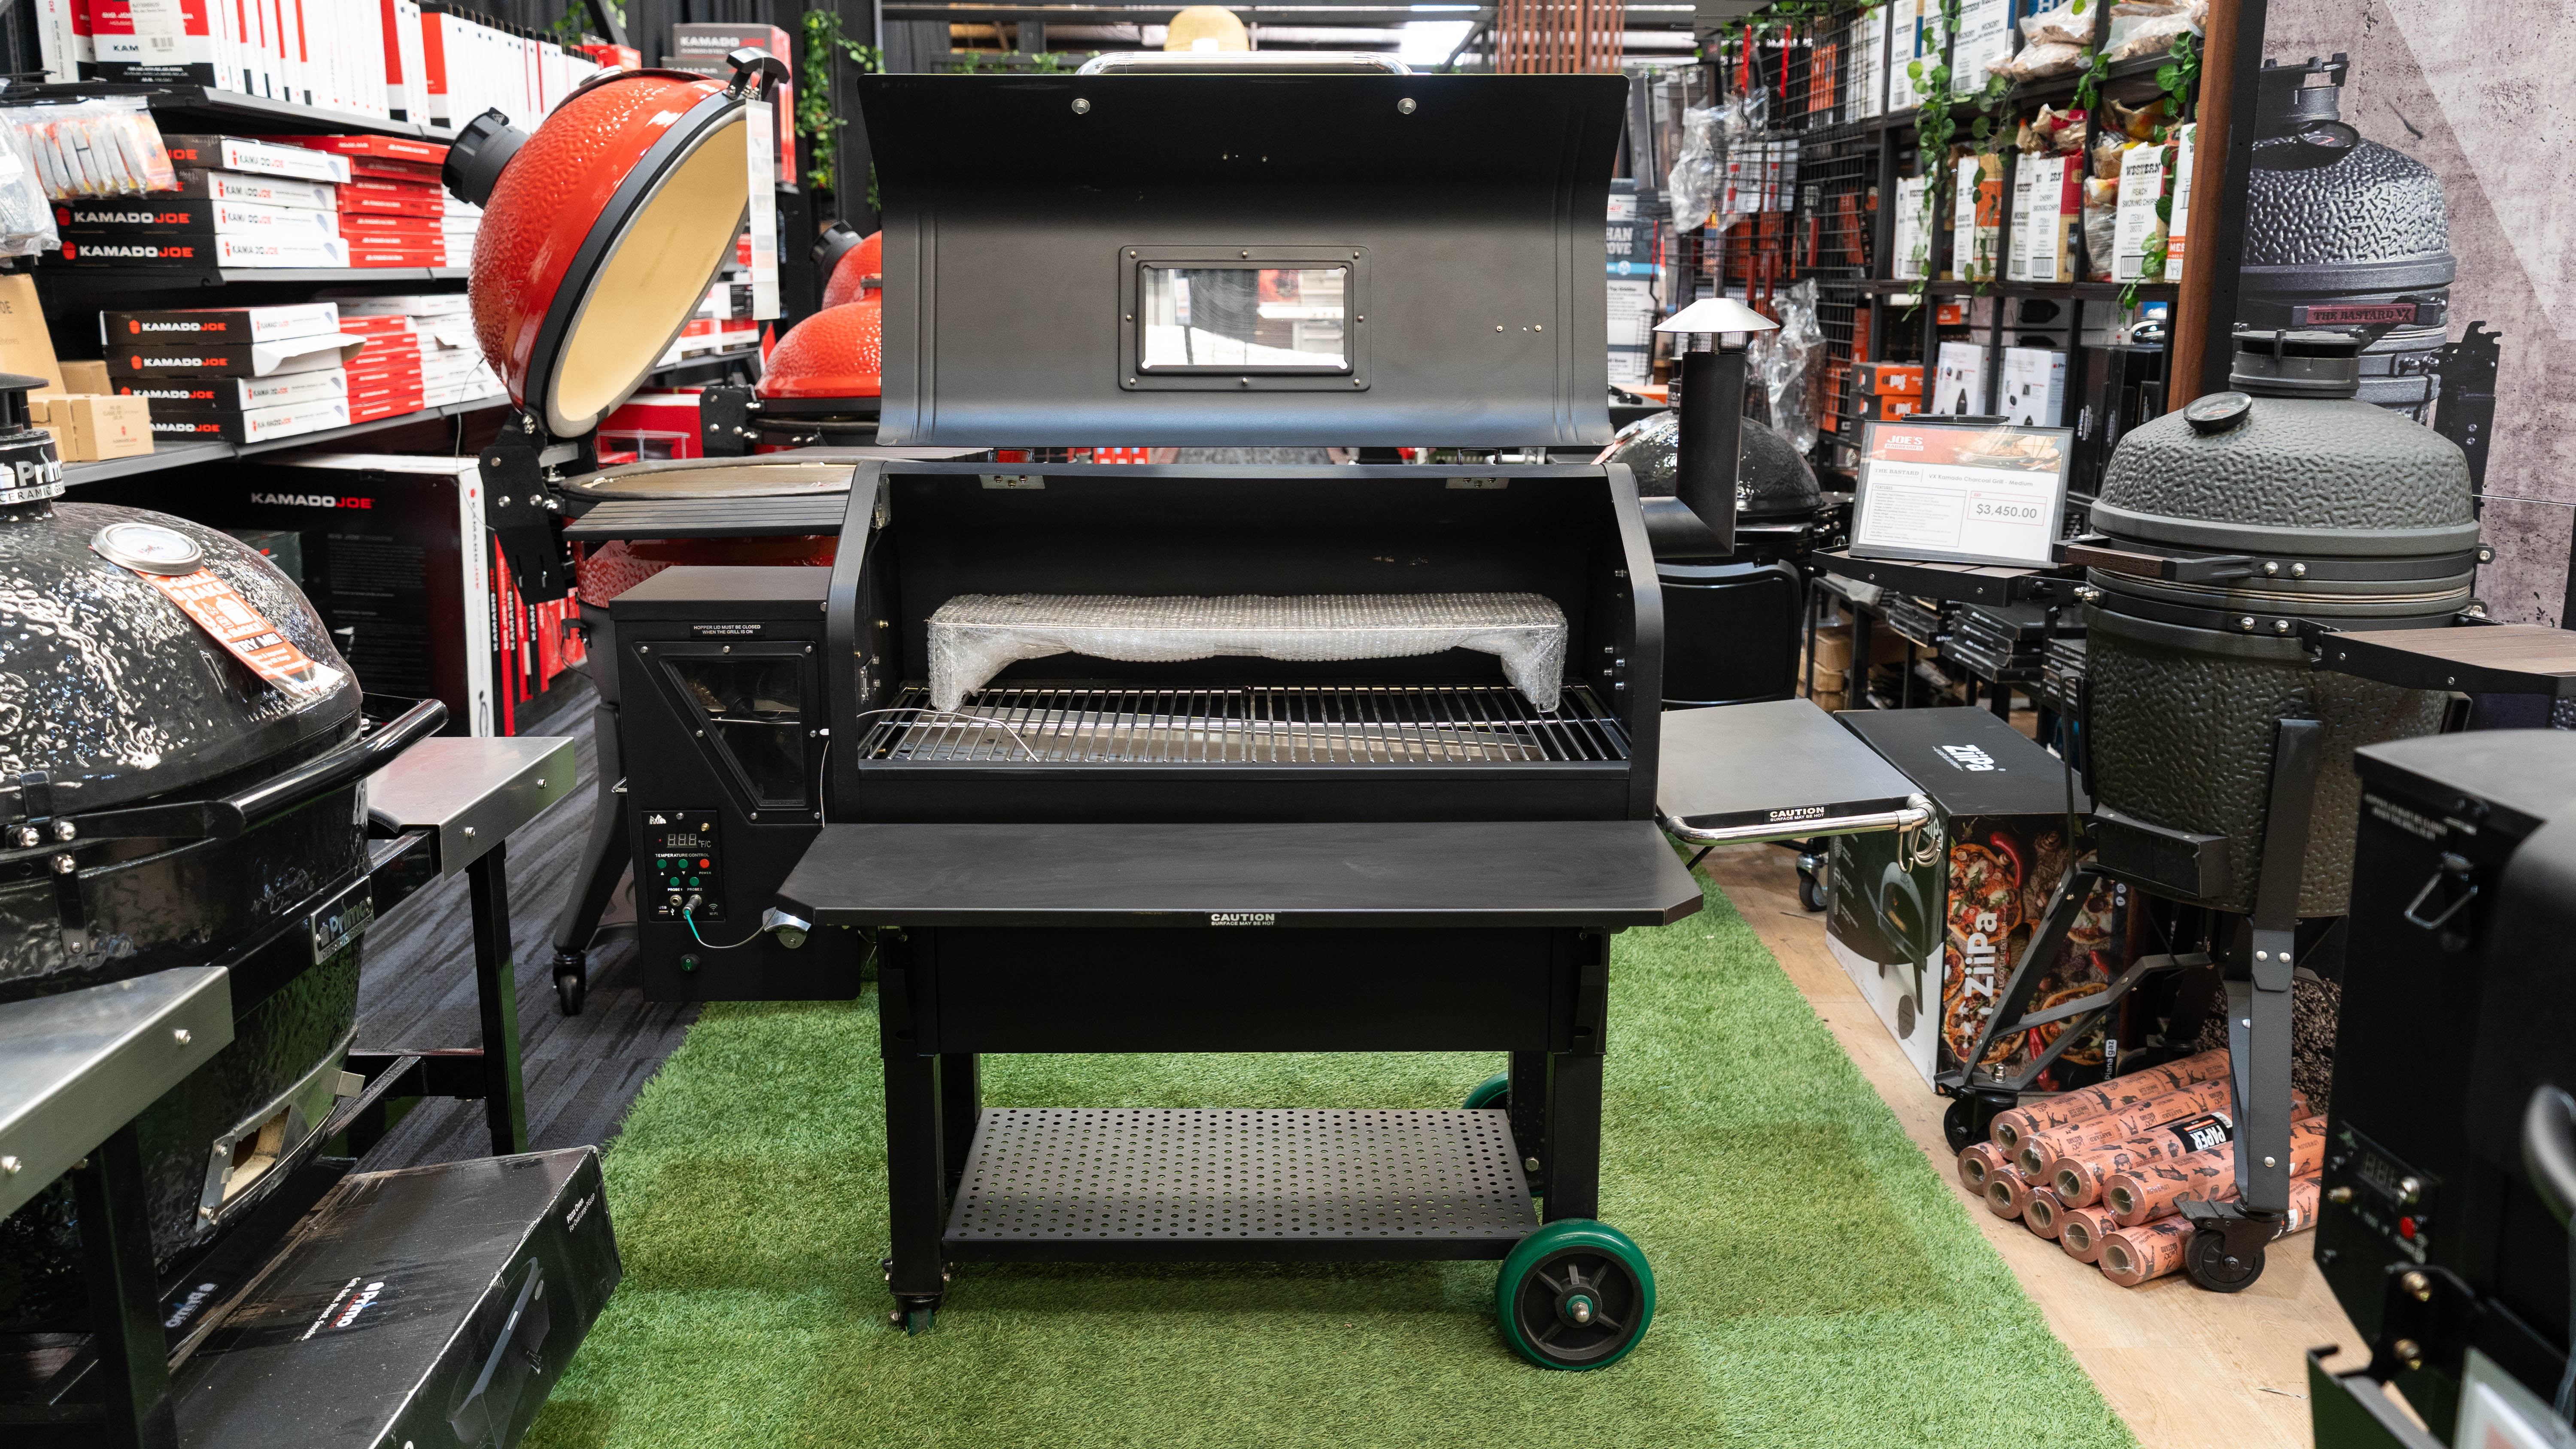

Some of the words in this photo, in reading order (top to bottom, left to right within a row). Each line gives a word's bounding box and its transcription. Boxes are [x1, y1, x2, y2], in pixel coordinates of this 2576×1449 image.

[2313, 312, 2337, 320] THE
[2341, 310, 2394, 320] BASTARD
[1887, 435, 1923, 445] JOE'S
[1976, 503, 2037, 518] $3,450.00
[1770, 807, 1824, 818] CAUTION
[1964, 912, 1998, 997] ZiiPa
[2190, 1125, 2227, 1150] PAPER
[567, 1209, 576, 1224] Pizza
[575, 1198, 584, 1212] Oven
[579, 1206, 587, 1218] Large
[337, 1291, 380, 1328] Primo
